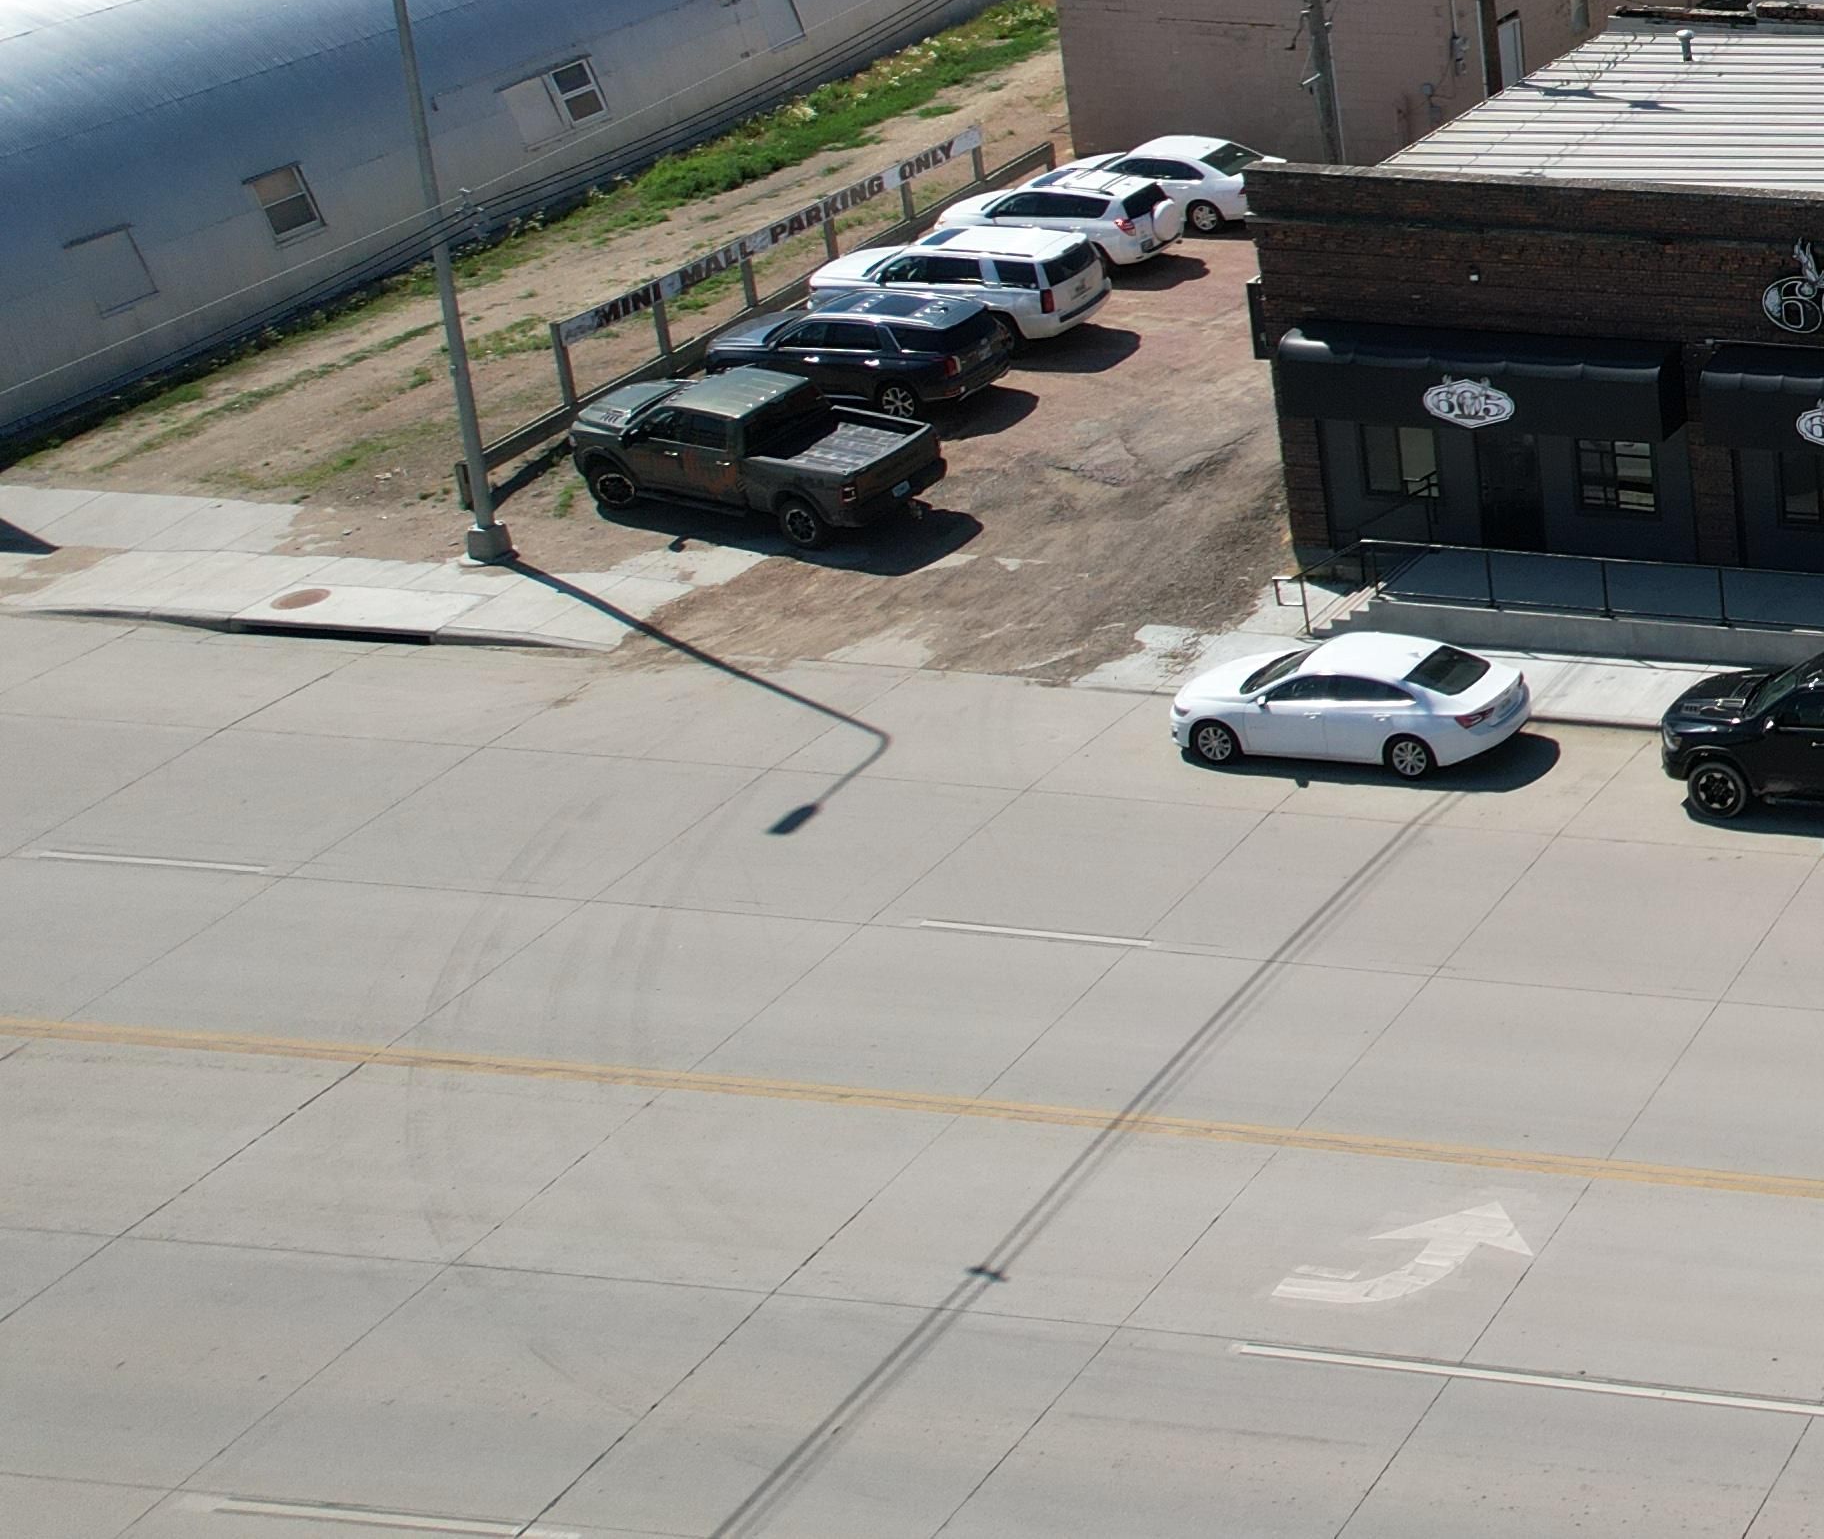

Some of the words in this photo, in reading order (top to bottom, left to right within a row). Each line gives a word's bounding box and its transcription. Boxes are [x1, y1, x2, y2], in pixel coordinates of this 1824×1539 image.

[597, 282, 662, 328] MINI
[679, 240, 755, 289] MALL
[769, 175, 885, 245] PARKING
[898, 141, 955, 183] ONLY
